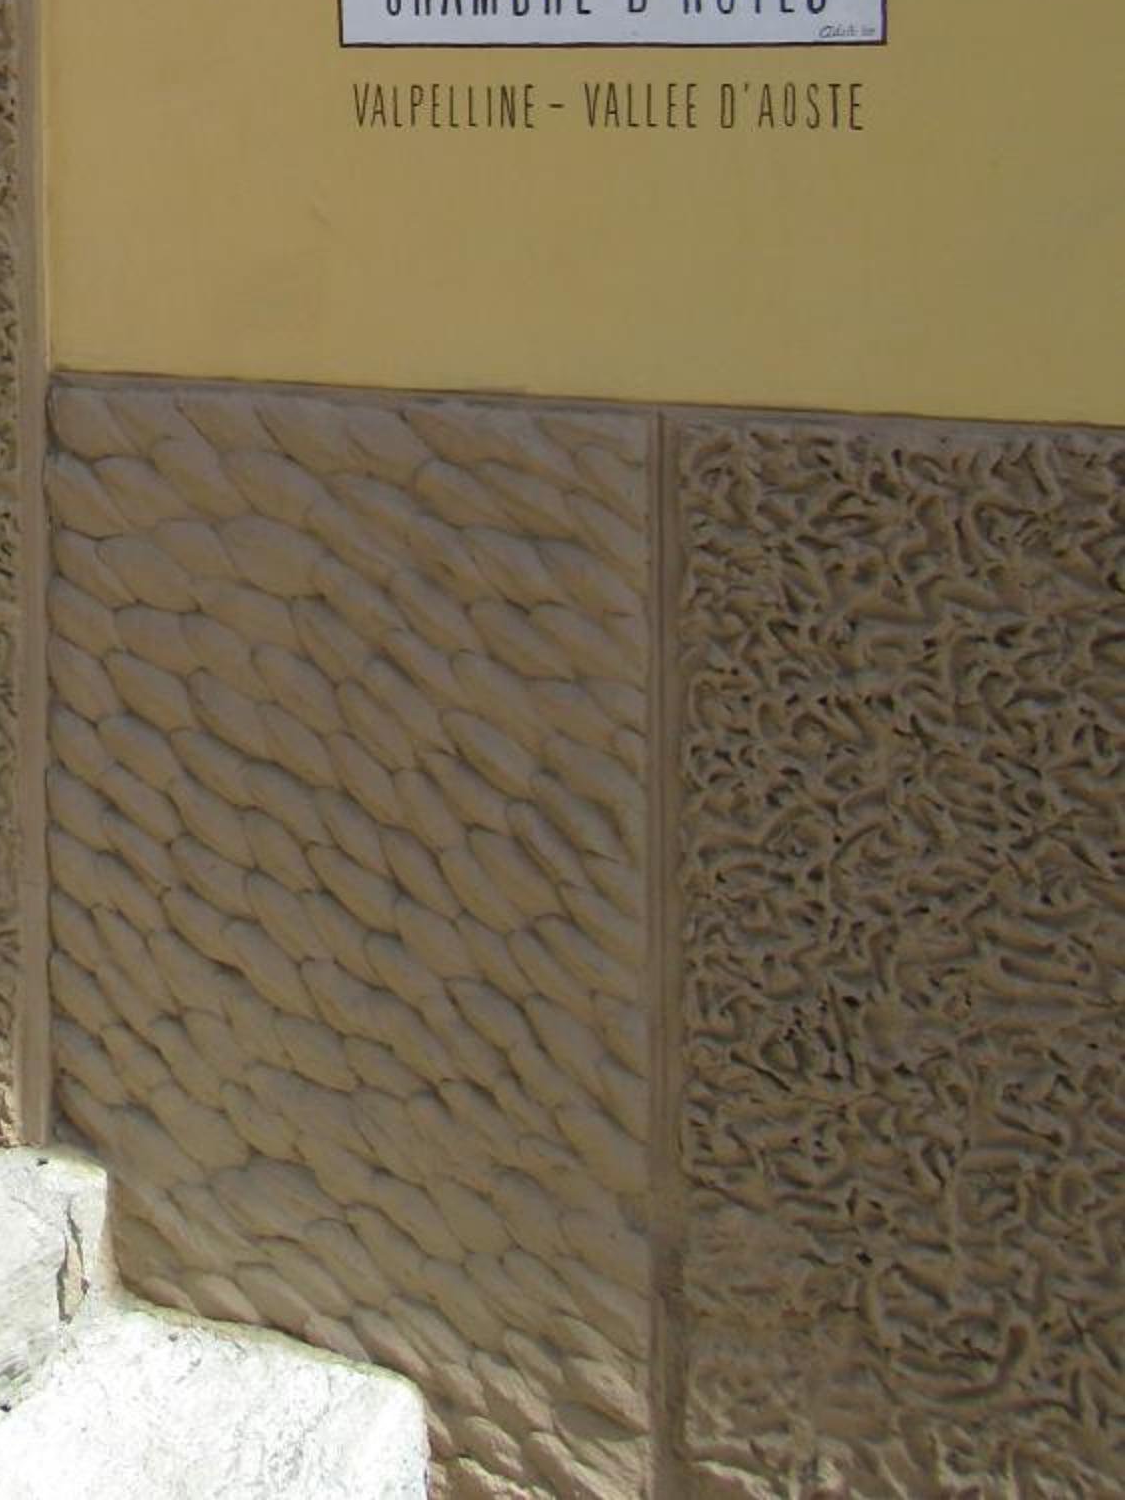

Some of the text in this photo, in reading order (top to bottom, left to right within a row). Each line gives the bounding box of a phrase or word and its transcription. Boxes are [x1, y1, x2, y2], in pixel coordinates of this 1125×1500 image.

[352, 82, 536, 130] VALPELLINE
[583, 81, 698, 130] VALLEE
[720, 82, 865, 131] D'AOSTE
